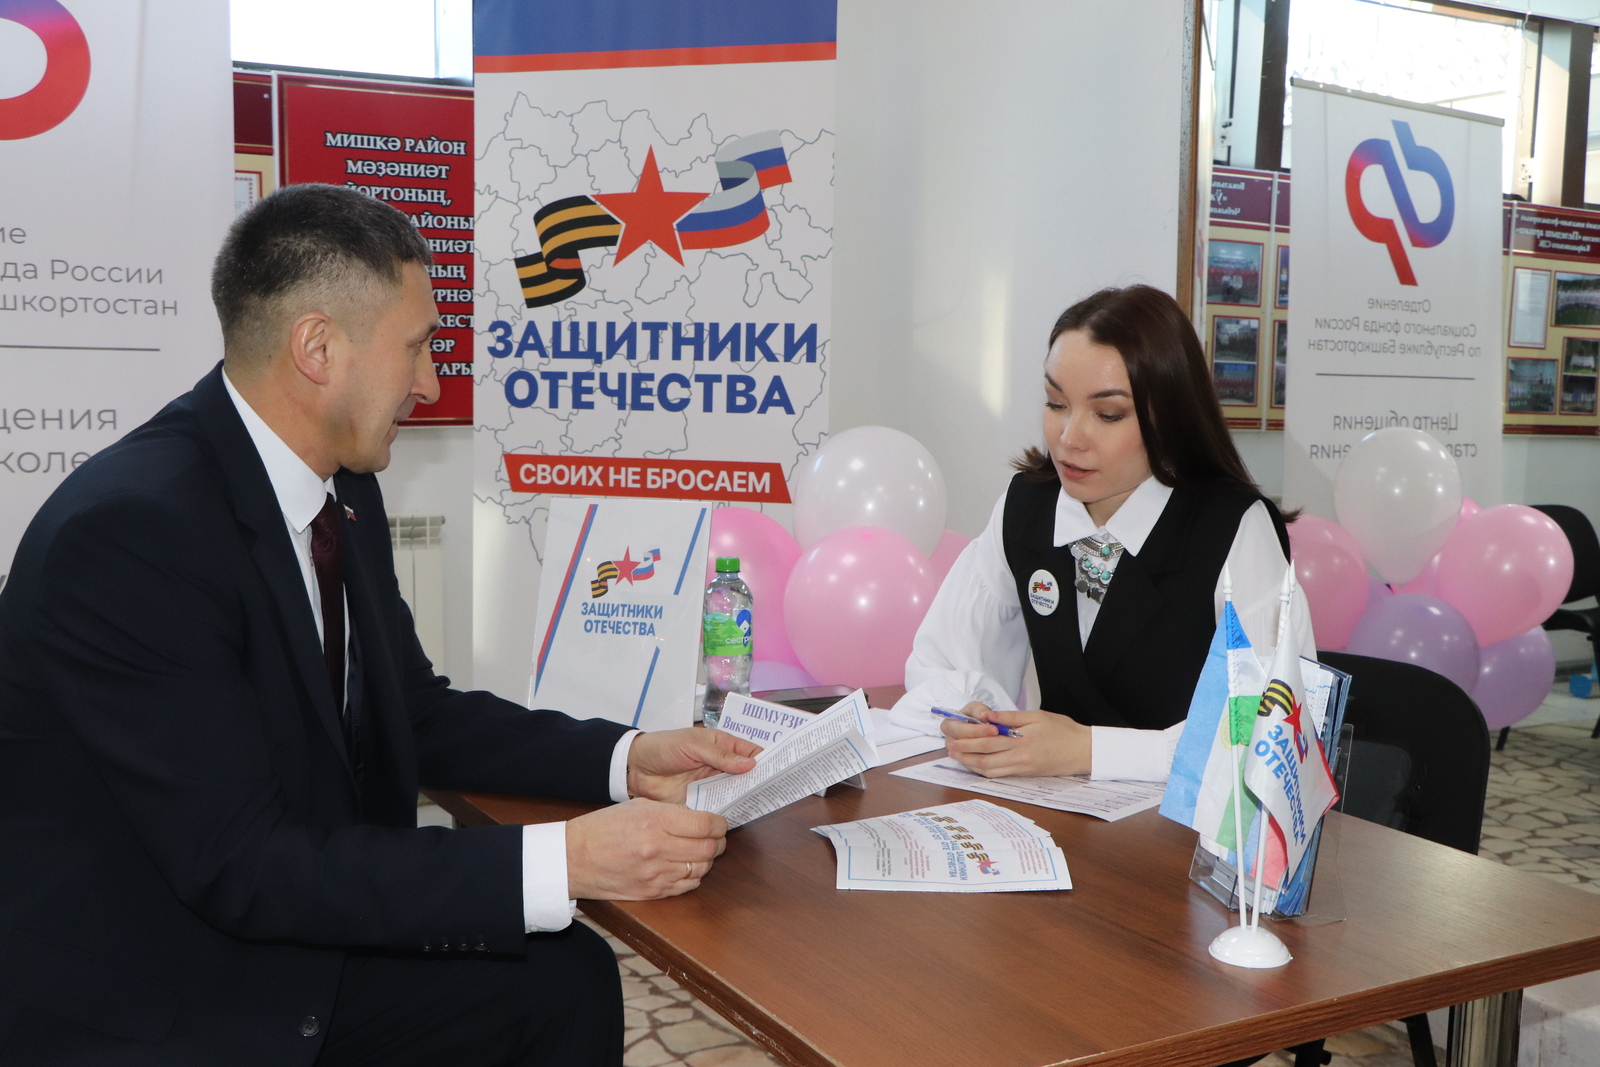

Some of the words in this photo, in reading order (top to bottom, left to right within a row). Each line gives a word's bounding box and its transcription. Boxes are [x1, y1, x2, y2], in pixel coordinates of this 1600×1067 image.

[325, 132, 402, 151] МИШКӘ
[404, 136, 467, 155] РАЙОН
[51, 259, 163, 284] России
[487, 320, 817, 364] ЗАЩИТНИКИ
[504, 371, 796, 415] ОТЕЧЕСТВА
[519, 462, 604, 487] СВОИХ
[608, 466, 641, 489] НЕ
[646, 467, 771, 494] БРОСАЕМ
[581, 601, 663, 620] ЗАЩИТНИКИ
[584, 619, 656, 637] ОТЕЧЕСТВА
[722, 716, 771, 741] Виктория
[741, 702, 808, 730] ИШМУРЗИ
[1254, 740, 1299, 847] ОТЕЧЕСТВА
[1267, 724, 1306, 845] ЗАЩИТНИКИ
